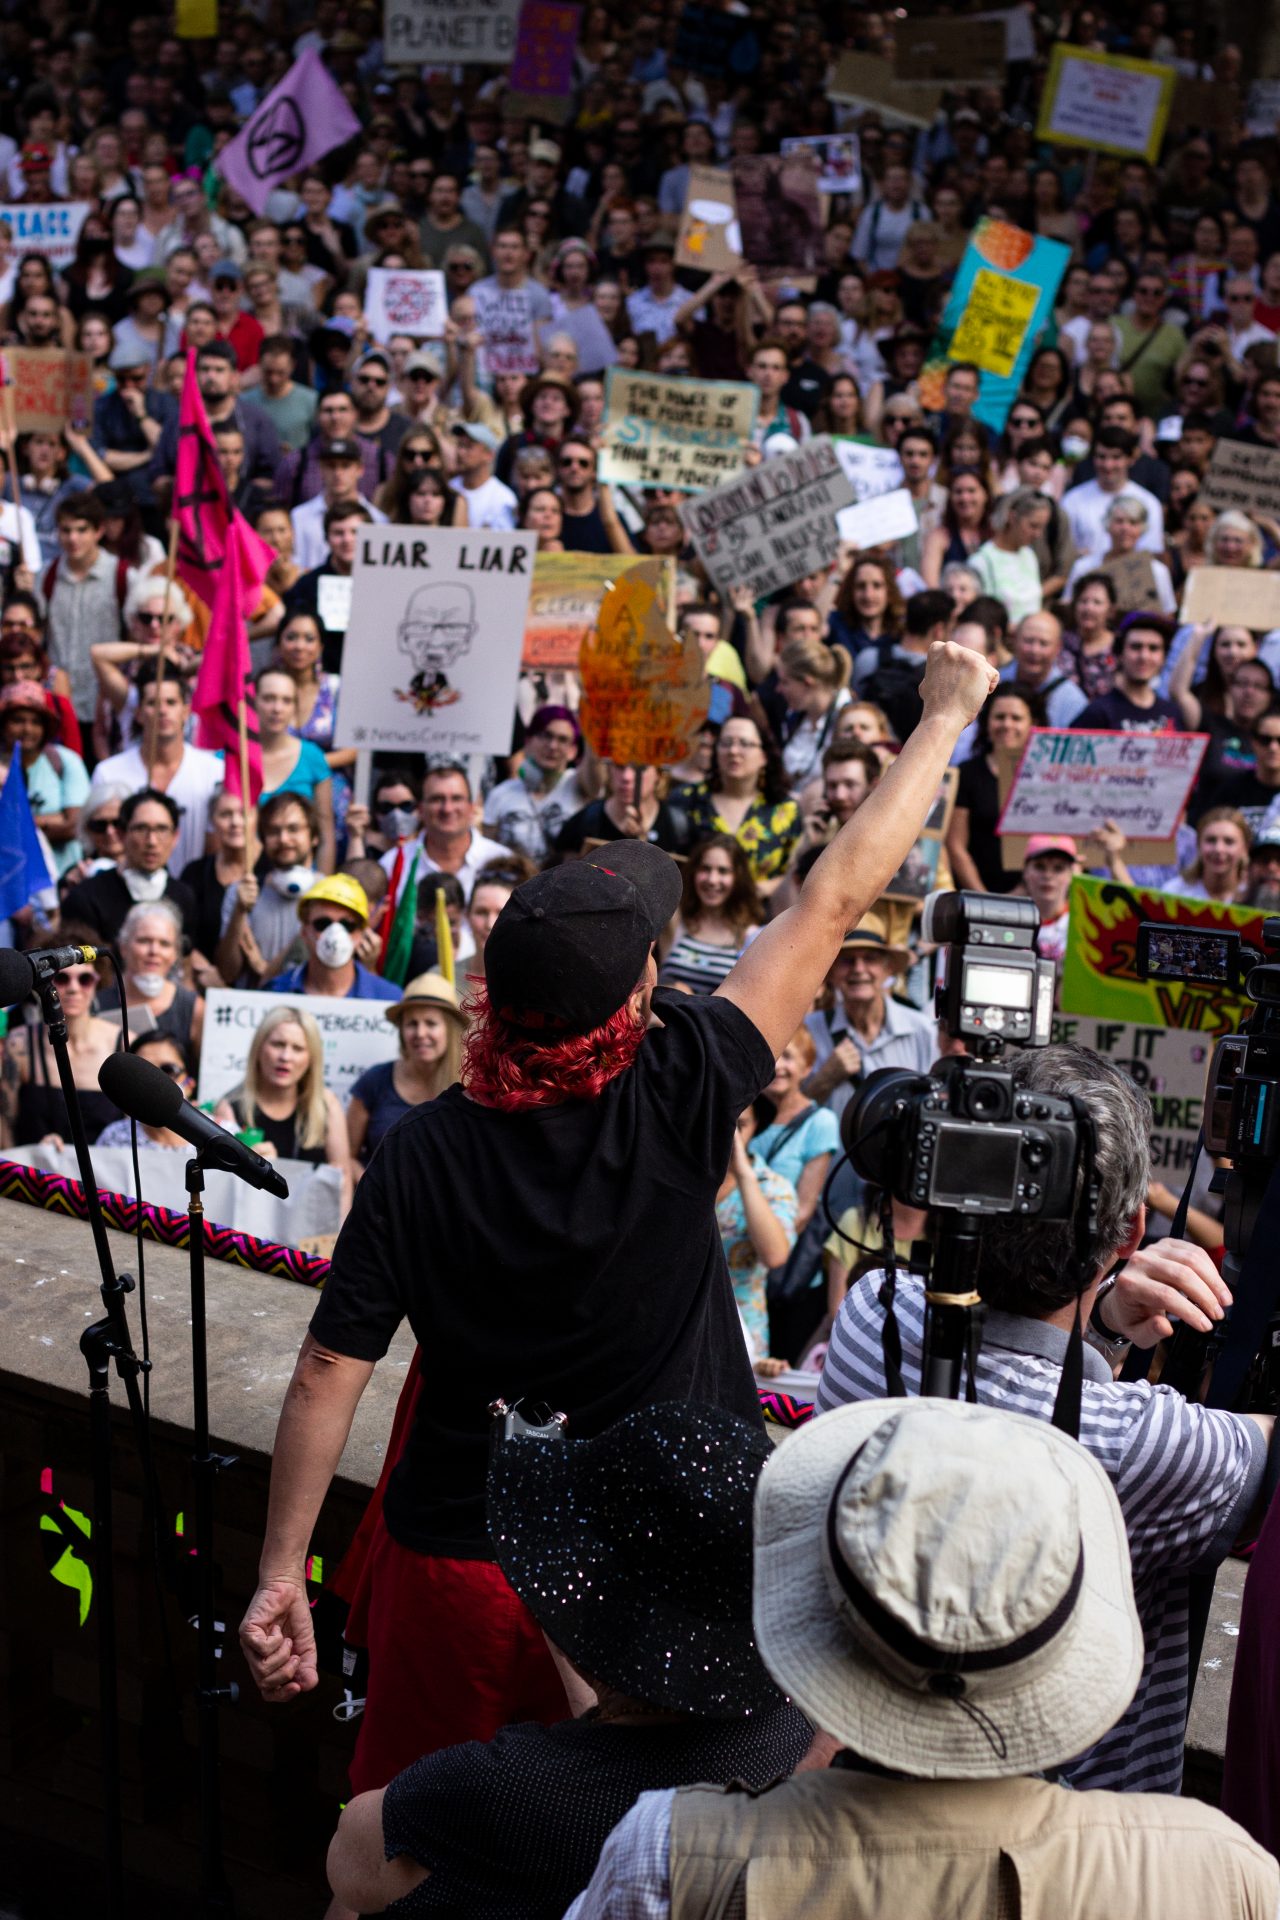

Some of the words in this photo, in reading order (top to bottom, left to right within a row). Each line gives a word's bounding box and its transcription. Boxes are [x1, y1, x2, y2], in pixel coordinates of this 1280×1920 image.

[390, 13, 489, 48] PLANET
[494, 13, 515, 50] B
[658, 406, 706, 426] PEOPLE
[694, 451, 739, 470] PEOPLE
[362, 539, 431, 568] LIAR
[458, 544, 527, 574] LIAR
[1118, 737, 1148, 762] for
[1012, 797, 1039, 817] for
[1052, 799, 1081, 817] the
[1089, 803, 1164, 831] country
[1096, 1024, 1126, 1051] IF
[1134, 1027, 1167, 1060] IT
[525, 1428, 549, 1439] TASCAM
